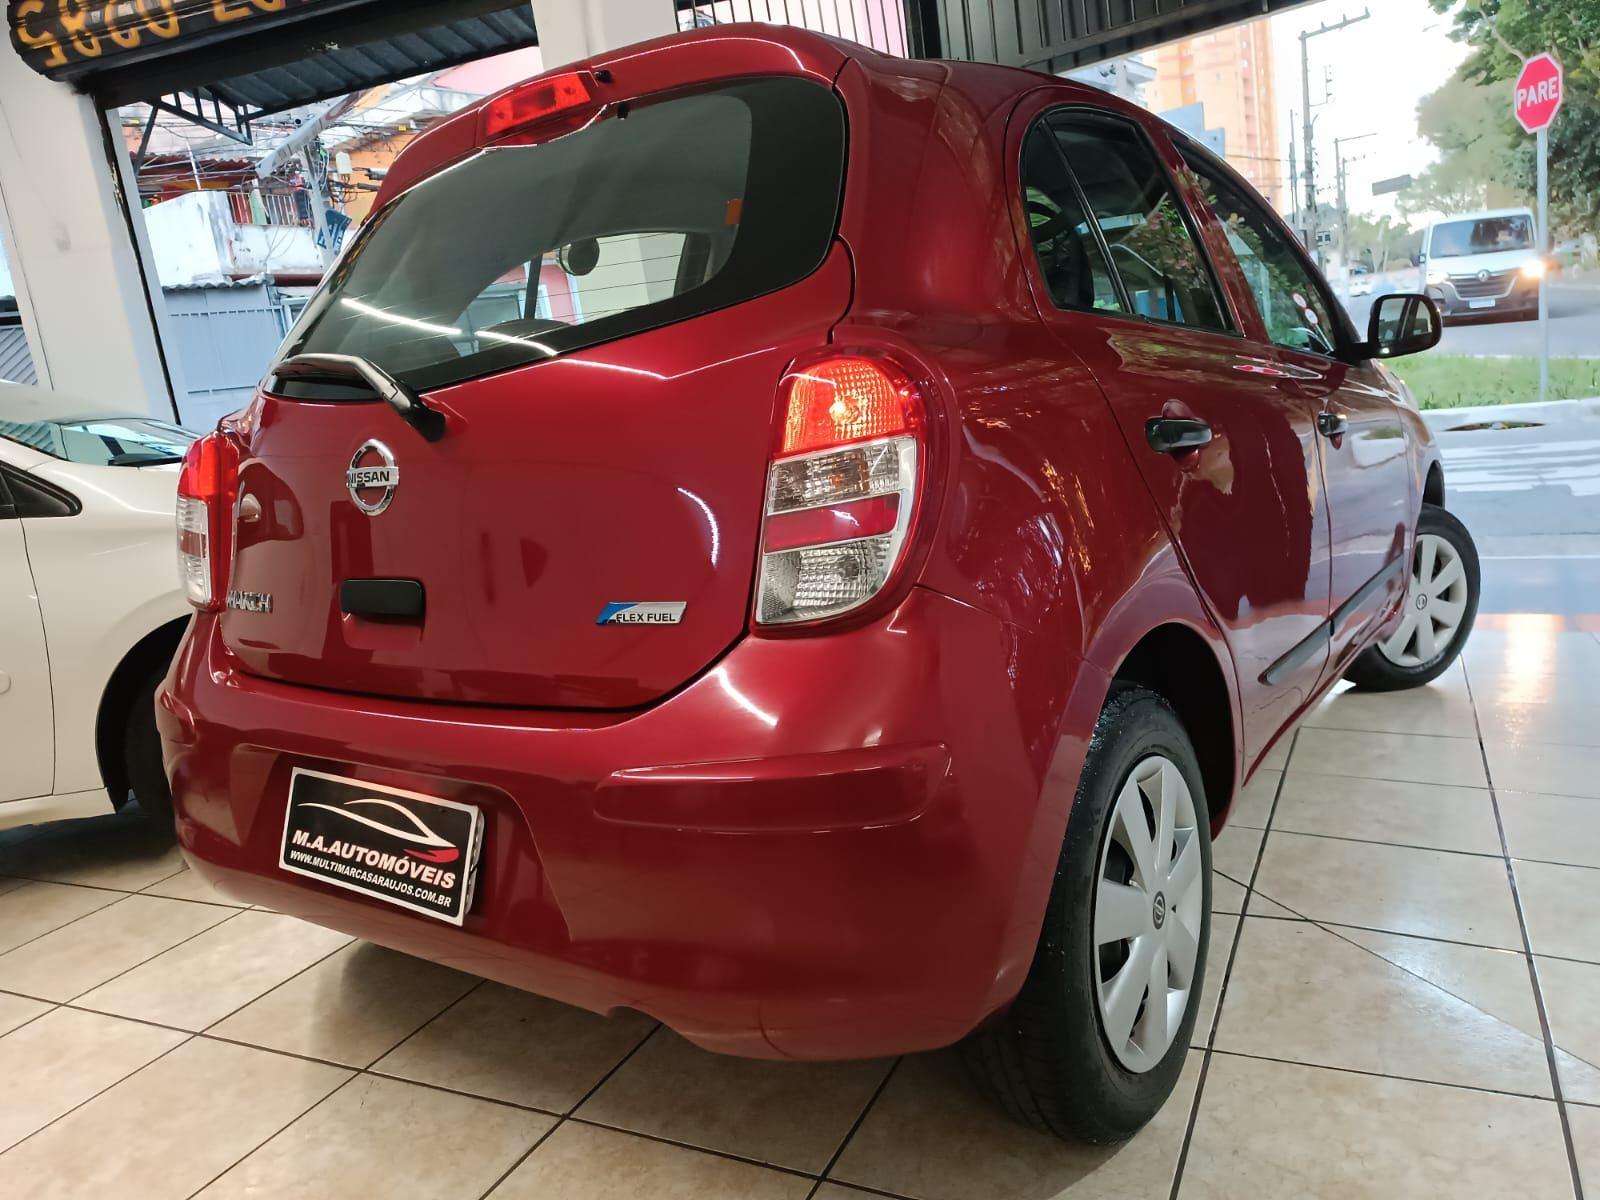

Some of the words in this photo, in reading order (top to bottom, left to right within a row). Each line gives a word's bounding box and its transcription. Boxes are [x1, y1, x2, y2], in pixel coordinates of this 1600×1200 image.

[1516, 76, 1559, 111] PARE
[616, 613, 644, 622] FLEX
[647, 613, 676, 622] FUEL
[290, 850, 452, 908] WWW.MULTIMARCASARAUJOS.COM.BR
